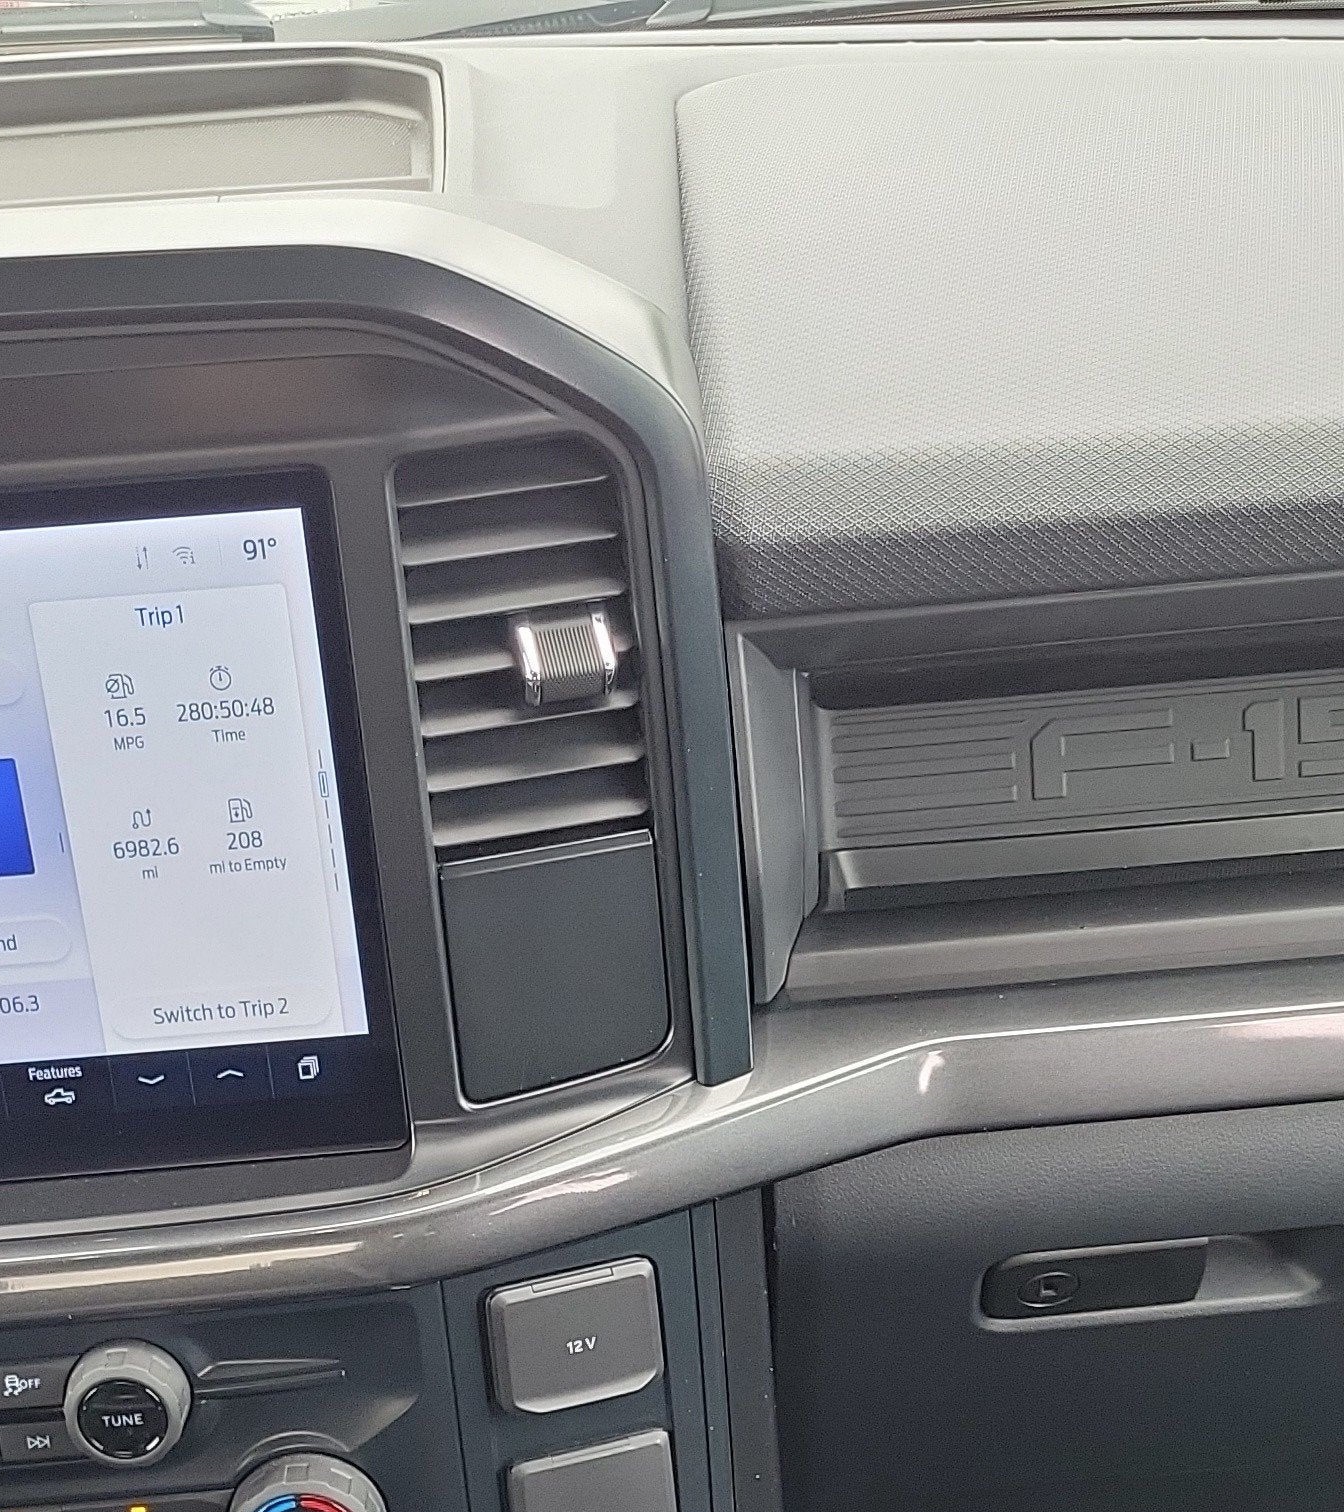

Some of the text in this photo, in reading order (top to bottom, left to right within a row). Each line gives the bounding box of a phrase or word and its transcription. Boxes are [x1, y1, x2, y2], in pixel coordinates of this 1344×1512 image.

[134, 604, 185, 629] Trip 1
[103, 696, 276, 729] 16.5 280:50:48
[113, 734, 146, 752] MPG
[211, 726, 247, 744] Time
[112, 830, 264, 861] 6982.6 208
[142, 864, 159, 880] mi
[209, 855, 288, 877] mi to Empty
[153, 997, 290, 1025] Switch to Trip 2
[27, 1064, 83, 1082] Features
[565, 1335, 597, 1356] 12 V
[18, 1376, 42, 1391] OFF
[100, 1412, 145, 1429] TUNE
